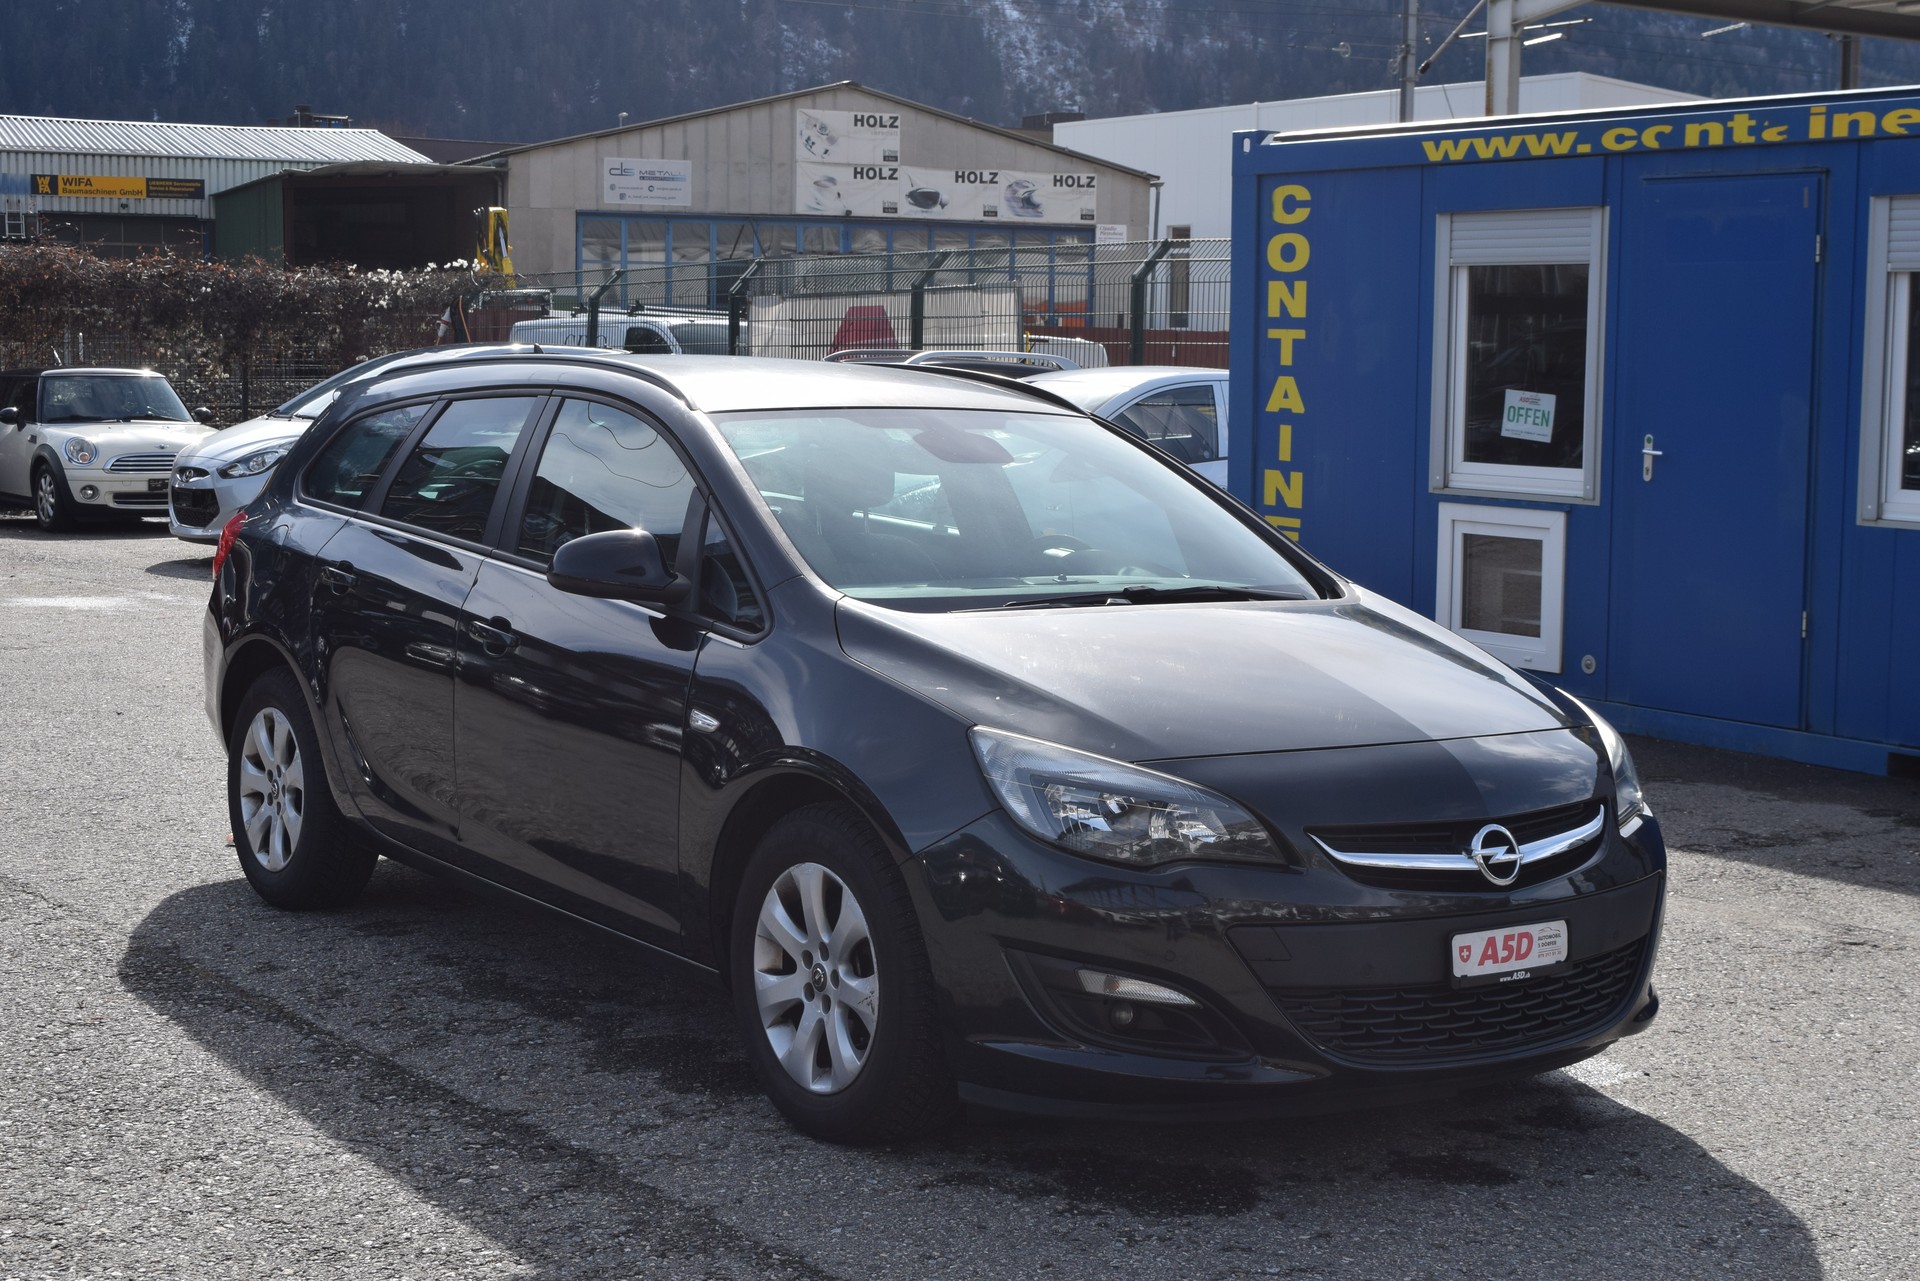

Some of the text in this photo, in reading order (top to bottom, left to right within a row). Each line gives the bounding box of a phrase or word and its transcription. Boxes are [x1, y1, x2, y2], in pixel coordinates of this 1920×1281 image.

[853, 114, 899, 129] HOLZ
[853, 167, 898, 180] HOLZ
[954, 171, 999, 185] HOLZ
[62, 177, 93, 187] WIFA
[1053, 175, 1096, 188] HOLZ
[62, 187, 117, 196] Baumaschinen
[1507, 405, 1550, 428] OFFEN
[1537, 932, 1562, 941] AUTOMOBIL
[1477, 931, 1534, 966] A5D
